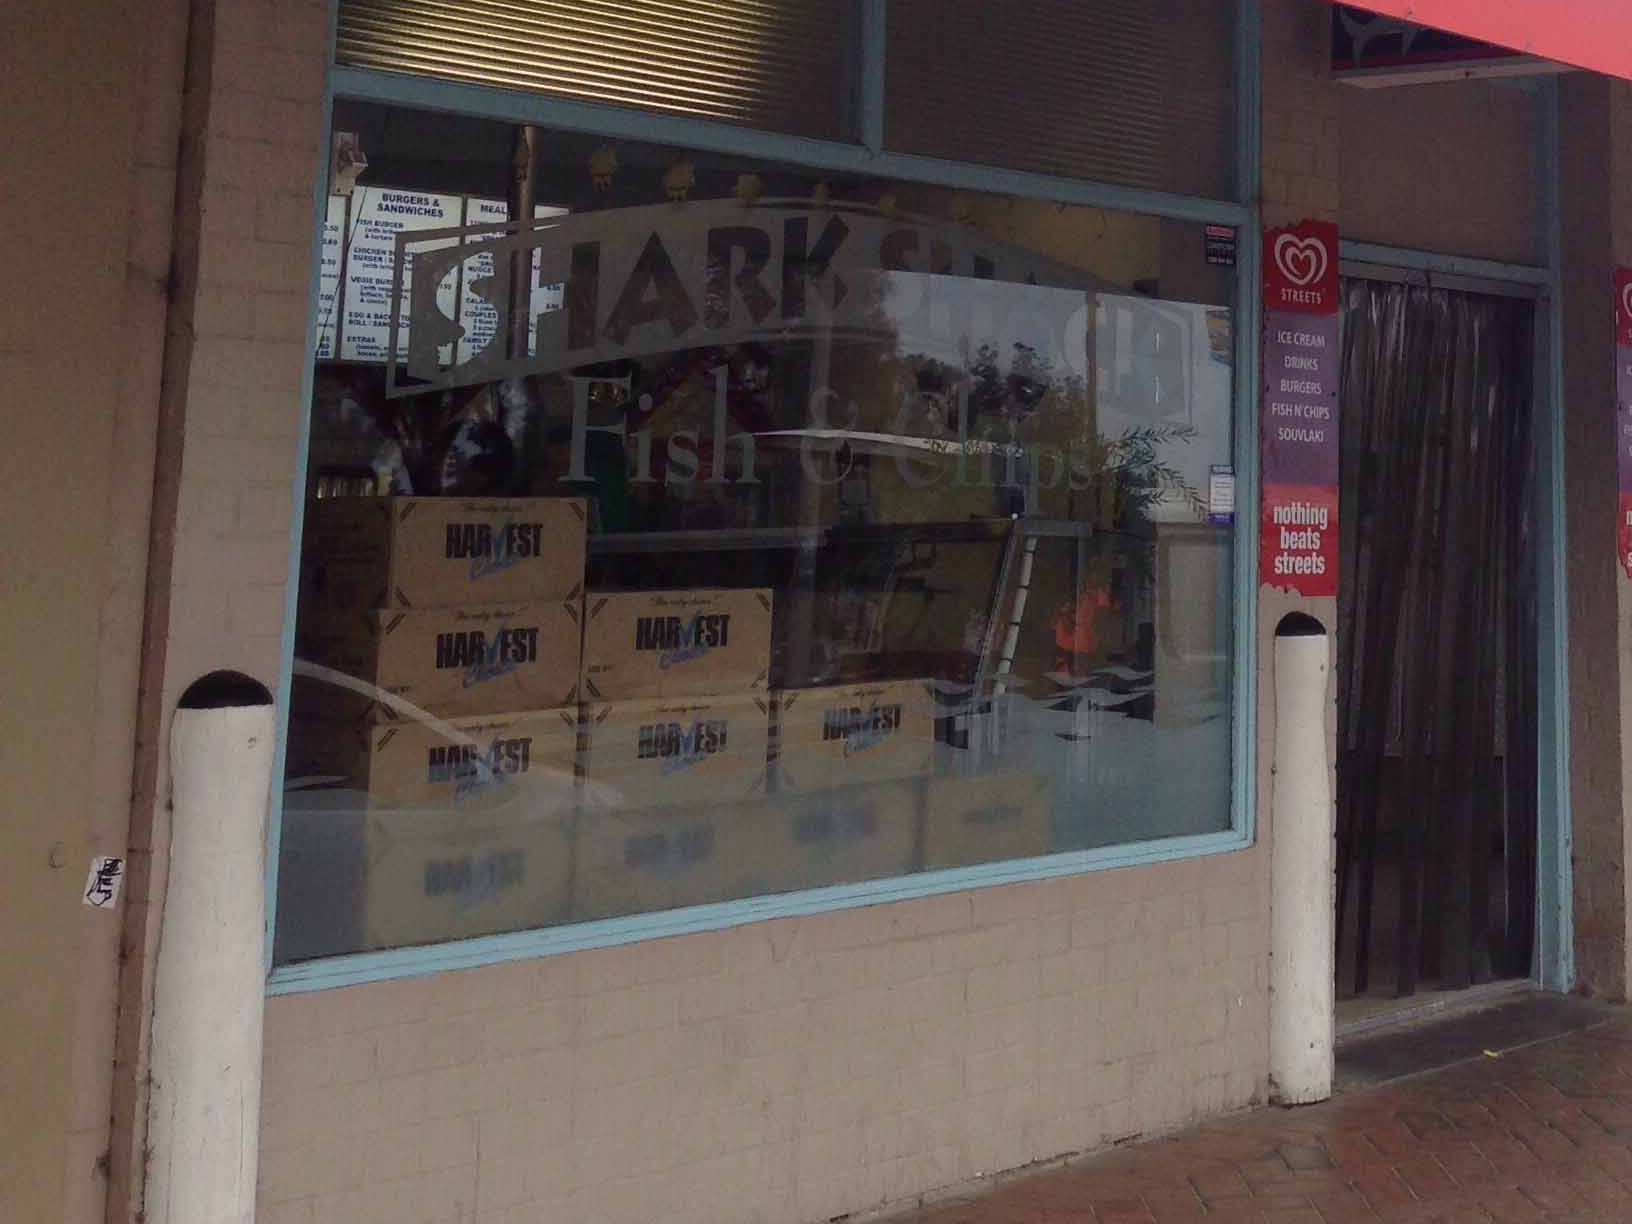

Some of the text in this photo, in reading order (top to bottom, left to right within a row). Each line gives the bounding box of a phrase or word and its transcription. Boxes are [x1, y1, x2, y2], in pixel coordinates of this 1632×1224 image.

[377, 203, 444, 218] SANDWICHES
[381, 193, 440, 207] BURGERS &
[434, 213, 851, 369] SHARK
[1280, 286, 1323, 305] STREETS
[1277, 328, 1326, 348] ICE CREAM
[1284, 355, 1319, 371] DRINKS
[1280, 378, 1322, 395] BURGERS
[1271, 401, 1293, 418] FISH
[1303, 407, 1331, 420] CHIPS
[557, 363, 763, 486] Fish
[1278, 425, 1325, 443] SOUVLAKI
[1273, 502, 1329, 529] nothing
[446, 521, 543, 559] HARVEST
[1280, 526, 1321, 550] beats
[1274, 551, 1325, 576] streets
[635, 611, 730, 651] HARVEST
[436, 626, 539, 669] HARVEST
